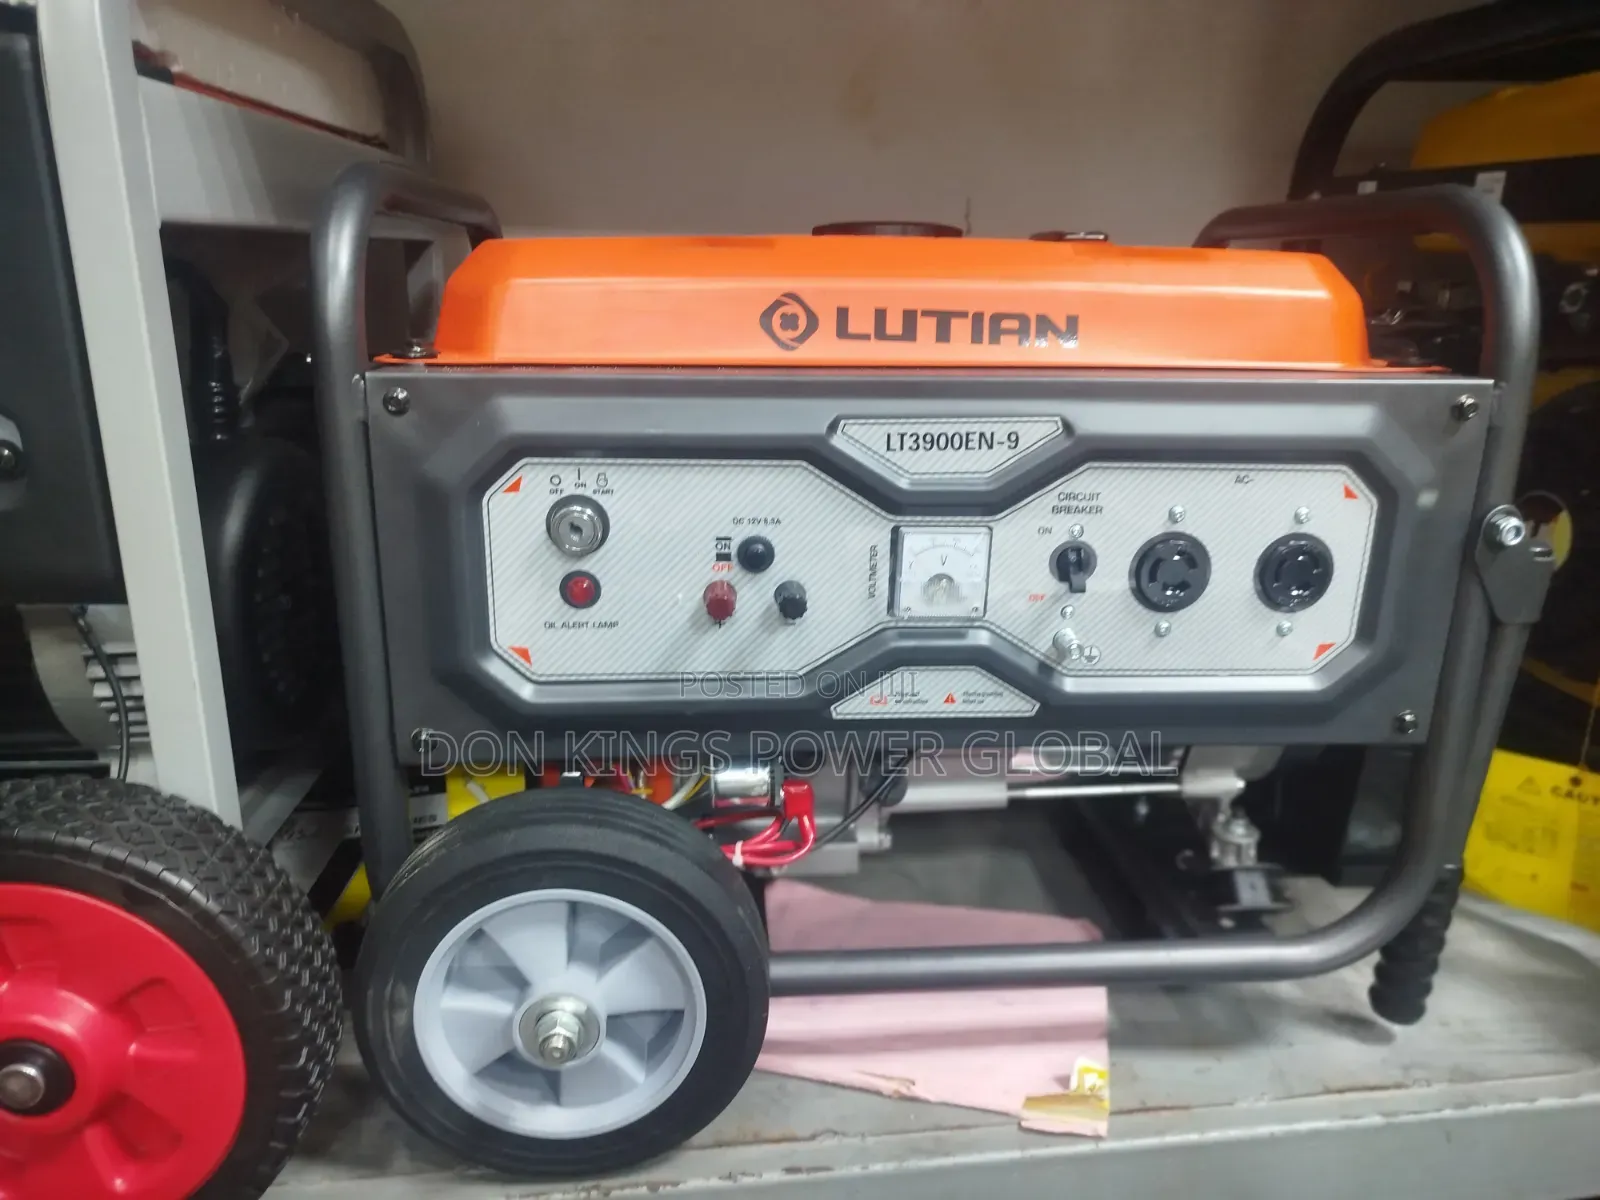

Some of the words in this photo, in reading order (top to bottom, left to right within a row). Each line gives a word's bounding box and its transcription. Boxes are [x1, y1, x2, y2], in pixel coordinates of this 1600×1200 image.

[835, 306, 1079, 348] LUTIAN
[885, 430, 1020, 452] LT3900EN-9
[1057, 491, 1101, 502] CIRCUIT
[1051, 504, 1103, 515] BREAKER
[732, 516, 745, 525] DC
[1037, 526, 1053, 535] ON
[715, 541, 731, 551] ON
[940, 554, 949, 566] V
[712, 562, 733, 572] OFF
[868, 544, 878, 600] VOLTMETER
[543, 620, 556, 629] OIL
[561, 621, 590, 630] ALERT
[592, 621, 619, 630] LAMP
